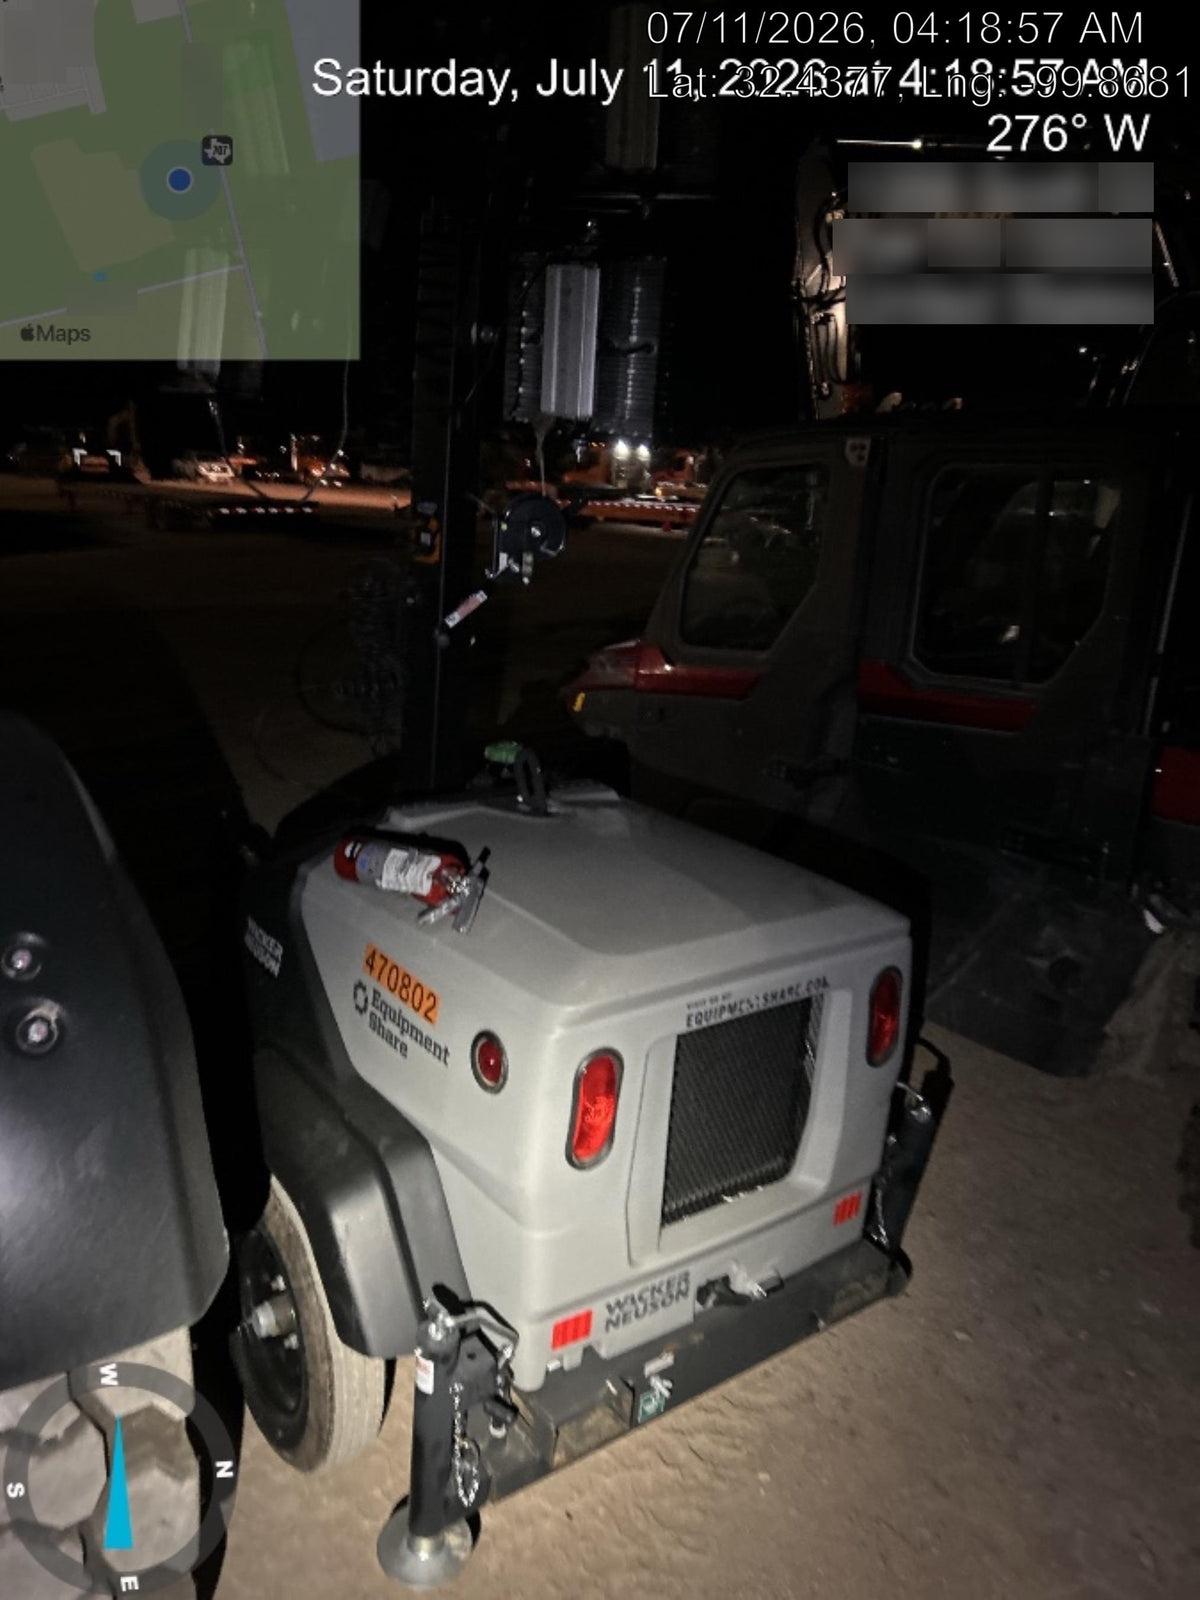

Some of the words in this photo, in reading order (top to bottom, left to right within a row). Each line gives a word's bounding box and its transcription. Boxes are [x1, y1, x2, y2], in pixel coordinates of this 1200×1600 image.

[365, 949, 438, 1025] 470802
[368, 1010, 409, 1060] Share
[371, 987, 450, 1067] Equipment
[604, 1279, 690, 1333] NEUSON
[605, 1269, 690, 1316] WACKER
